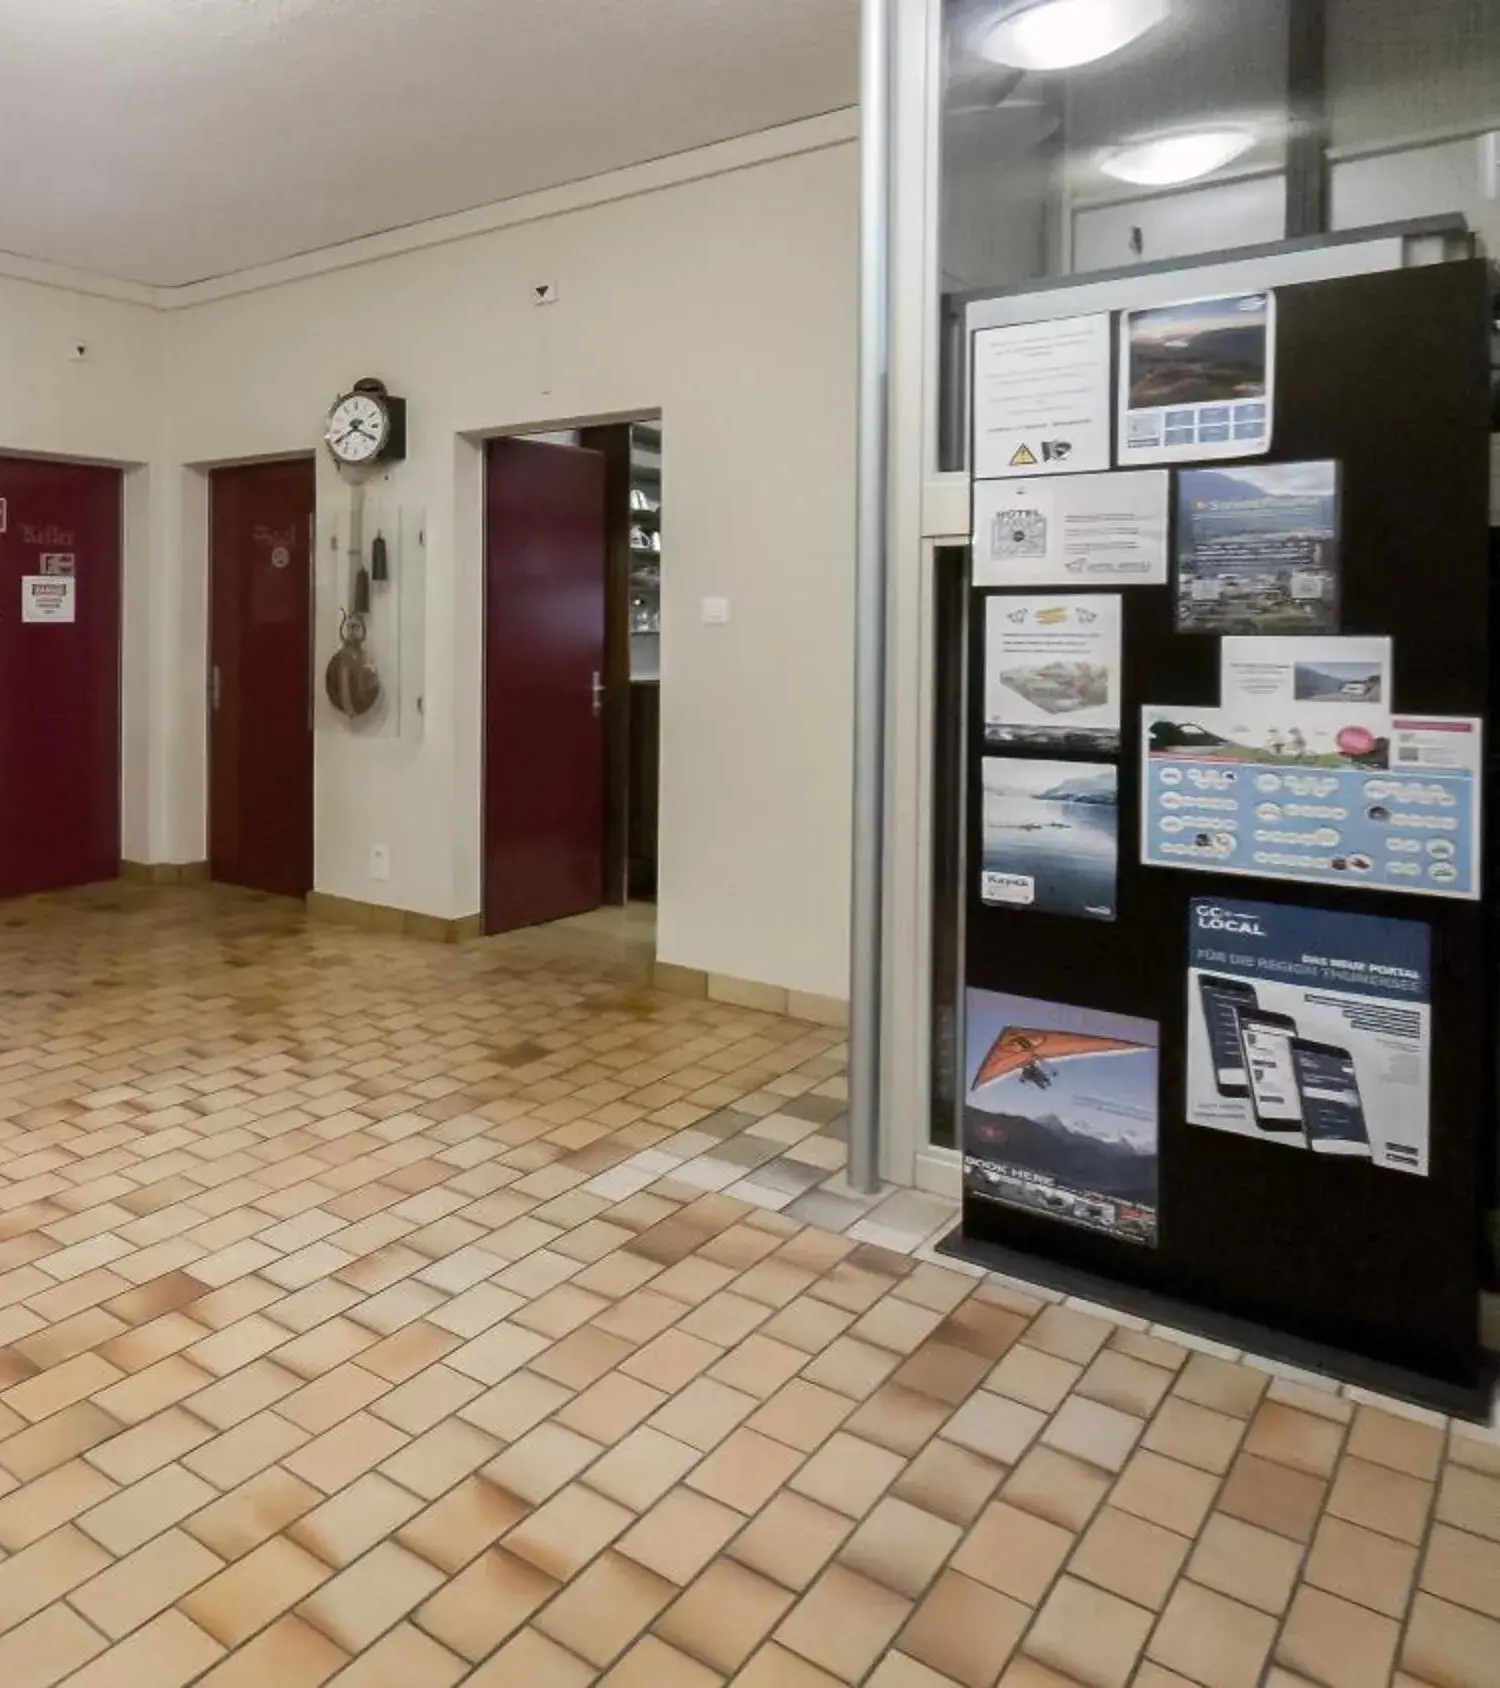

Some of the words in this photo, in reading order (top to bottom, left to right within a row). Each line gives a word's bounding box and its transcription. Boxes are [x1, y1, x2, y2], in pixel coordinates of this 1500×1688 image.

[1198, 918, 1267, 936] LOCAL
[1257, 957, 1321, 977] REGION
[1369, 963, 1421, 979] PORTAL
